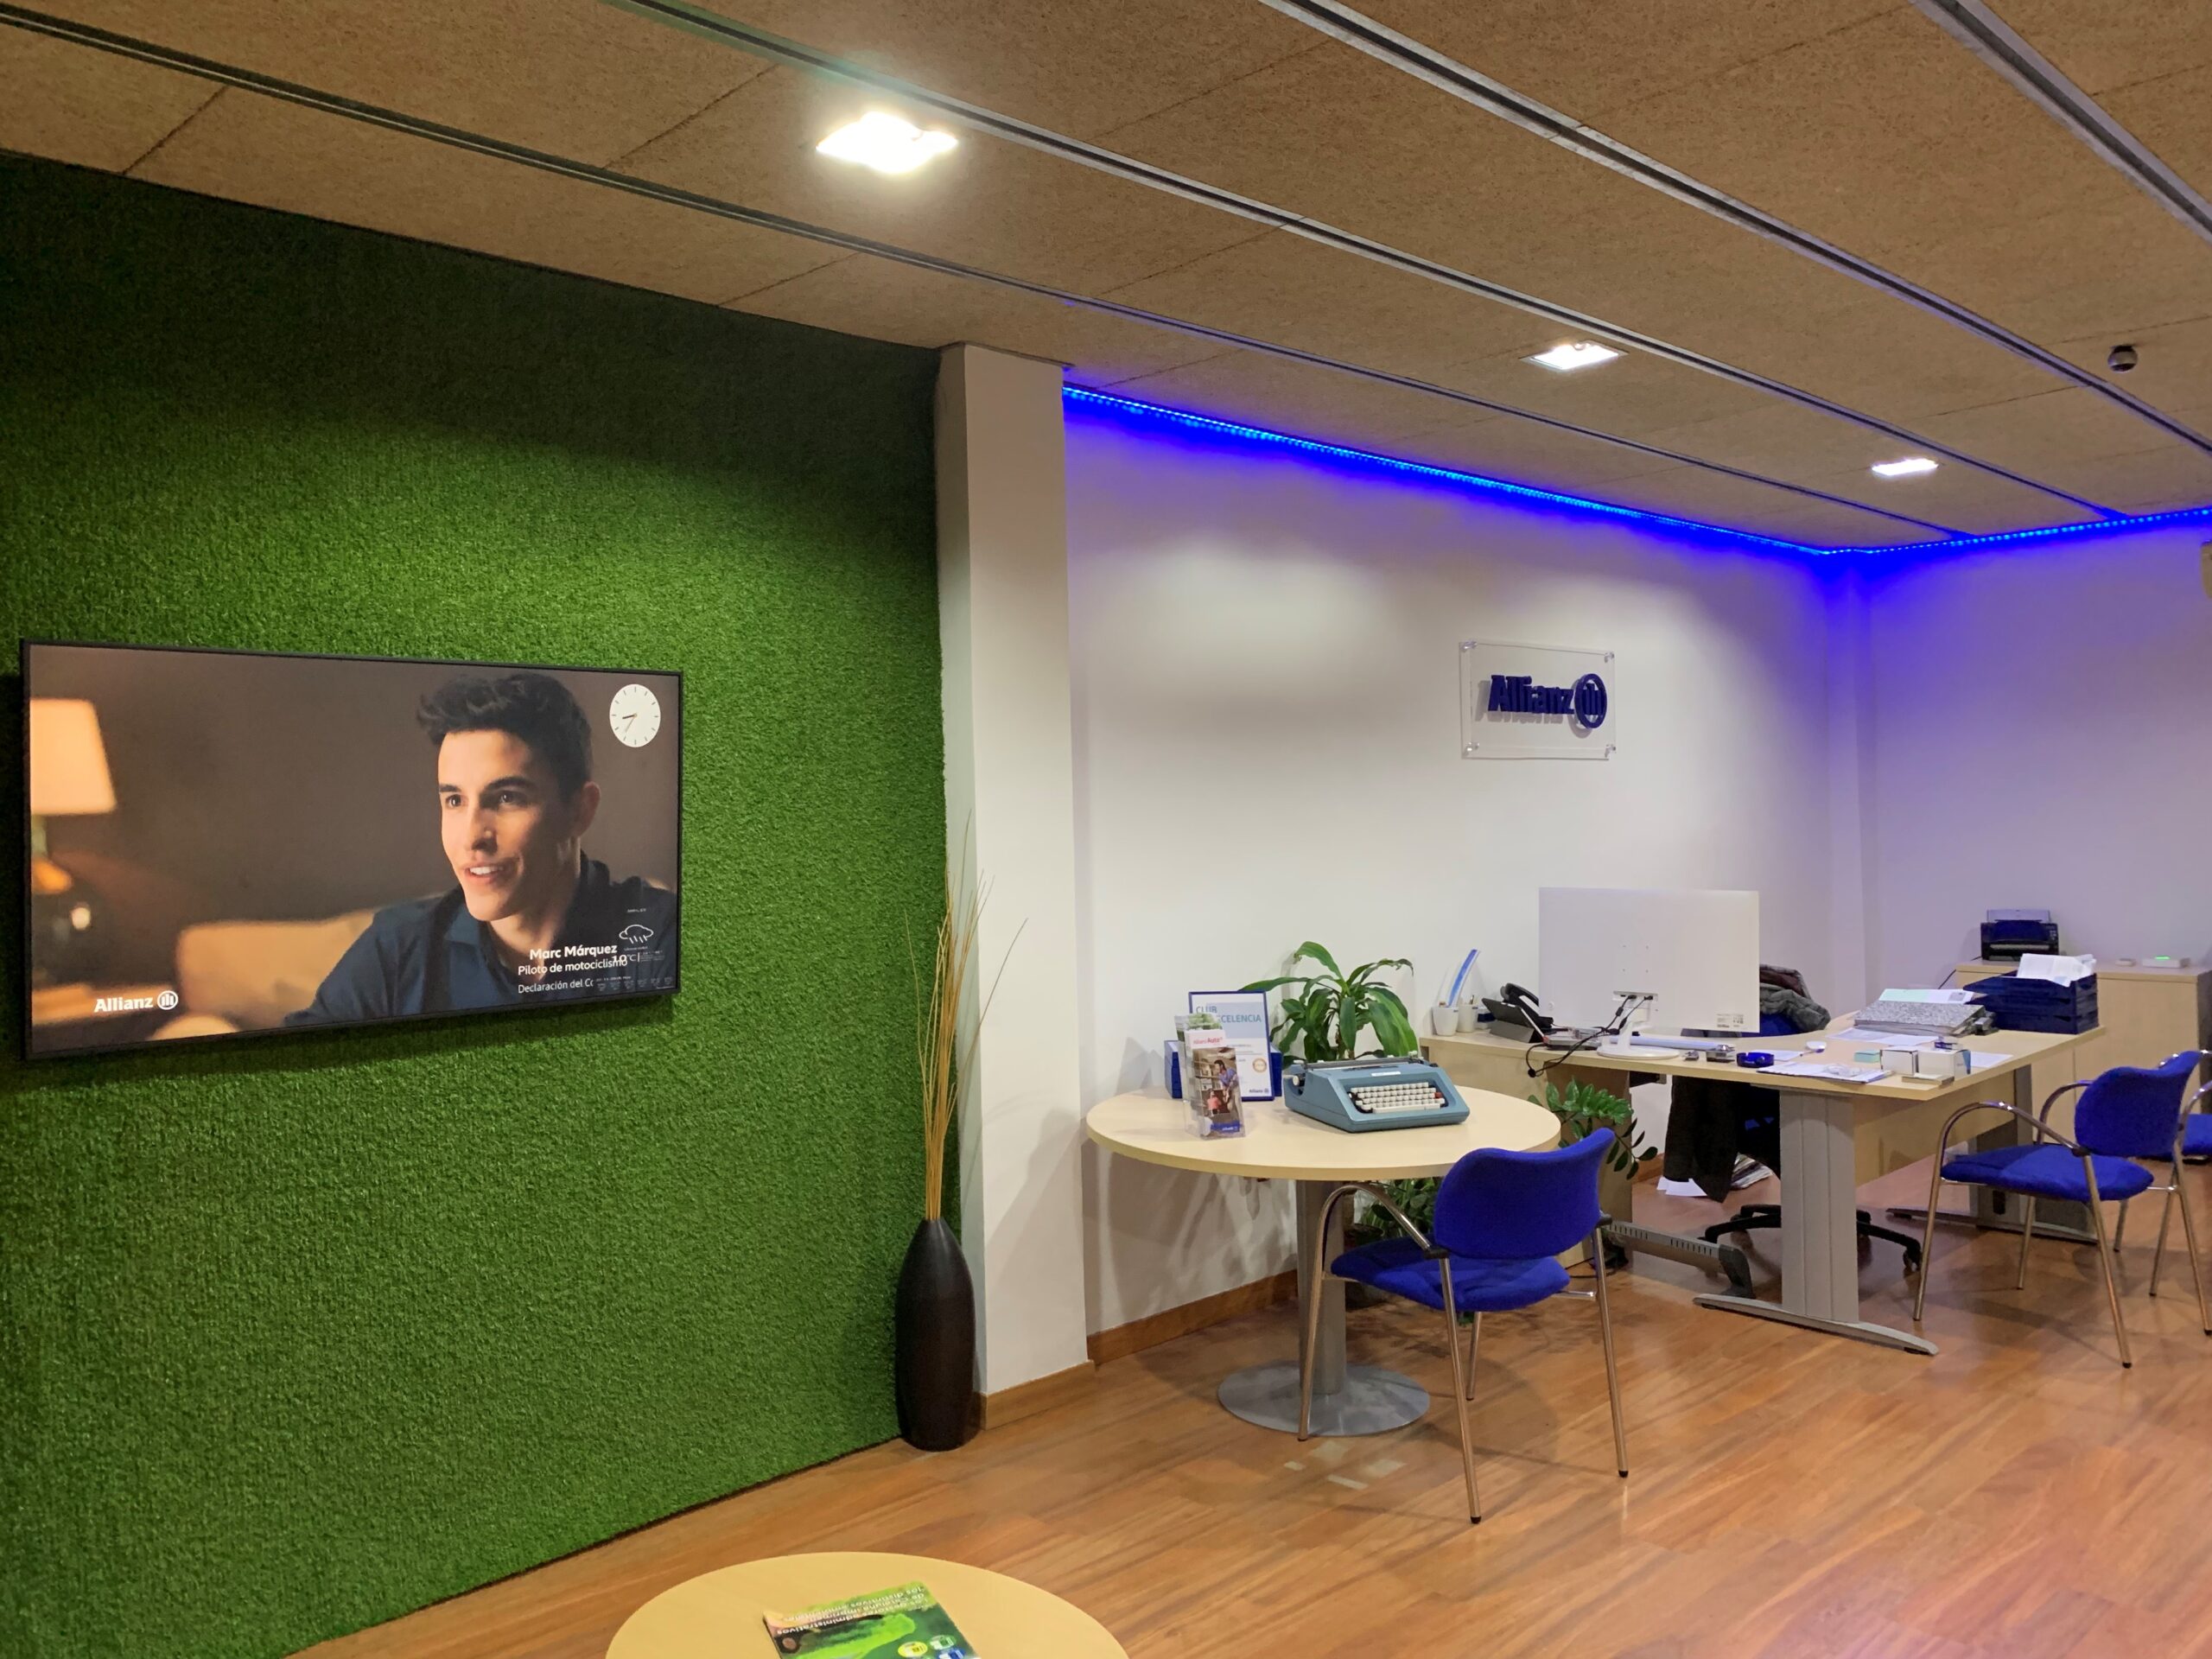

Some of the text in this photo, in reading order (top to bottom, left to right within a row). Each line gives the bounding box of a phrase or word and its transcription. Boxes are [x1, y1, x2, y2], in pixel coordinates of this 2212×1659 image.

[1488, 675, 1574, 715] Allianz
[530, 944, 618, 961] Marc Márquez
[518, 963, 547, 976] Piloto
[550, 961, 563, 973] de
[564, 957, 628, 972] motociclismo
[518, 978, 569, 994] Declaración
[569, 978, 583, 989] del
[93, 996, 154, 1013] Allianz
[1217, 1014, 1262, 1023] CELENCIA
[777, 1614, 858, 1635] administrativos
